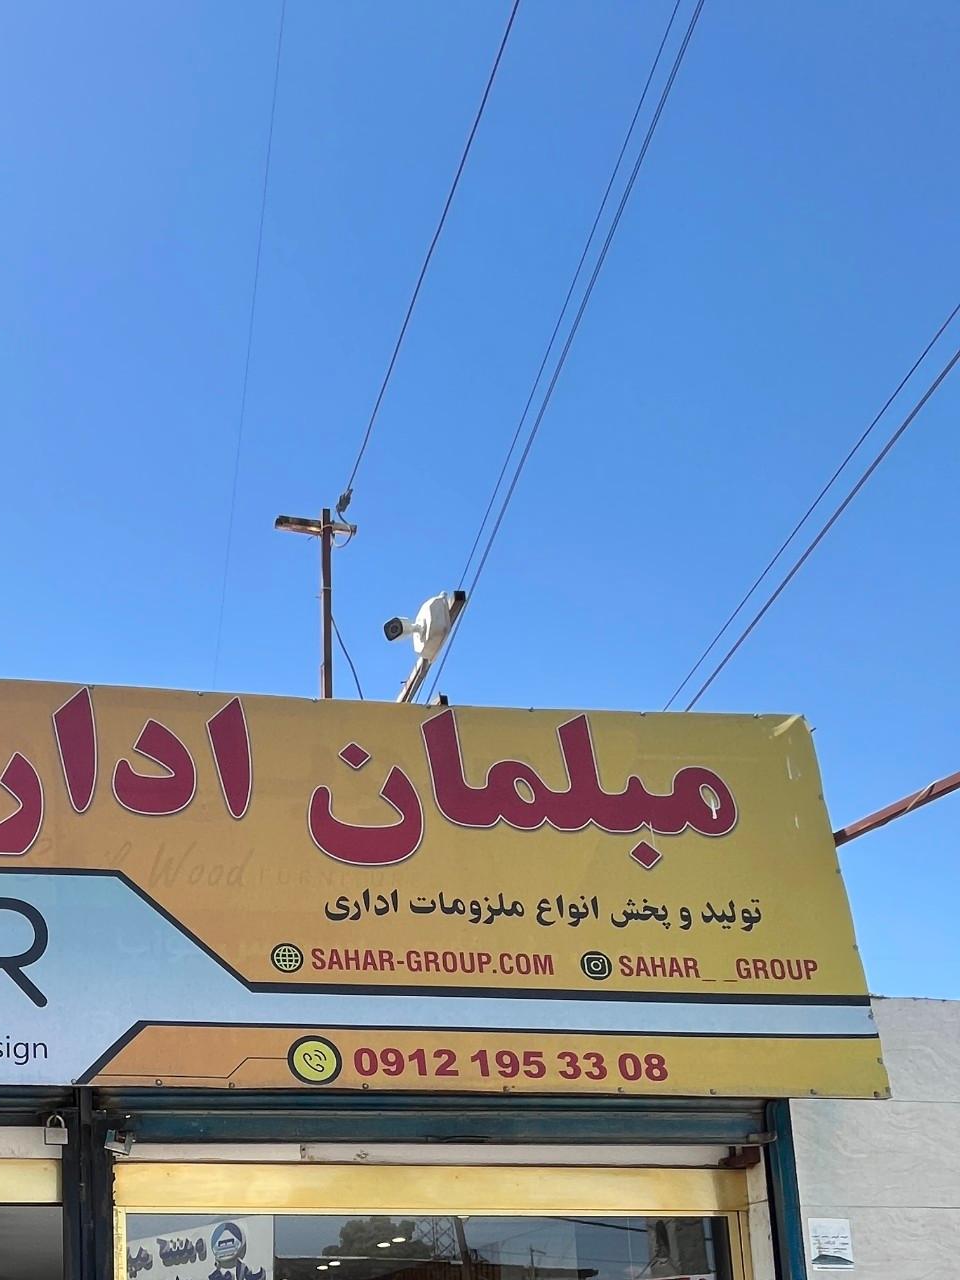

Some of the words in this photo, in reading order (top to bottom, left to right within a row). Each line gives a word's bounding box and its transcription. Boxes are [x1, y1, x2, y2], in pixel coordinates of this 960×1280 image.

[309, 708, 738, 869] مبلمان
[324, 888, 398, 921] اداری
[409, 891, 525, 927] ملزومات
[536, 894, 599, 927] انواع
[610, 899, 671, 931] پخش
[680, 905, 692, 931] و
[701, 897, 762, 932] تولید
[311, 947, 555, 977] SAHAR-GROUP.COM
[353, 1047, 460, 1077] 0912
[470, 1049, 547, 1080] 195
[556, 1051, 608, 1081] 33
[617, 1052, 669, 1082] 08
